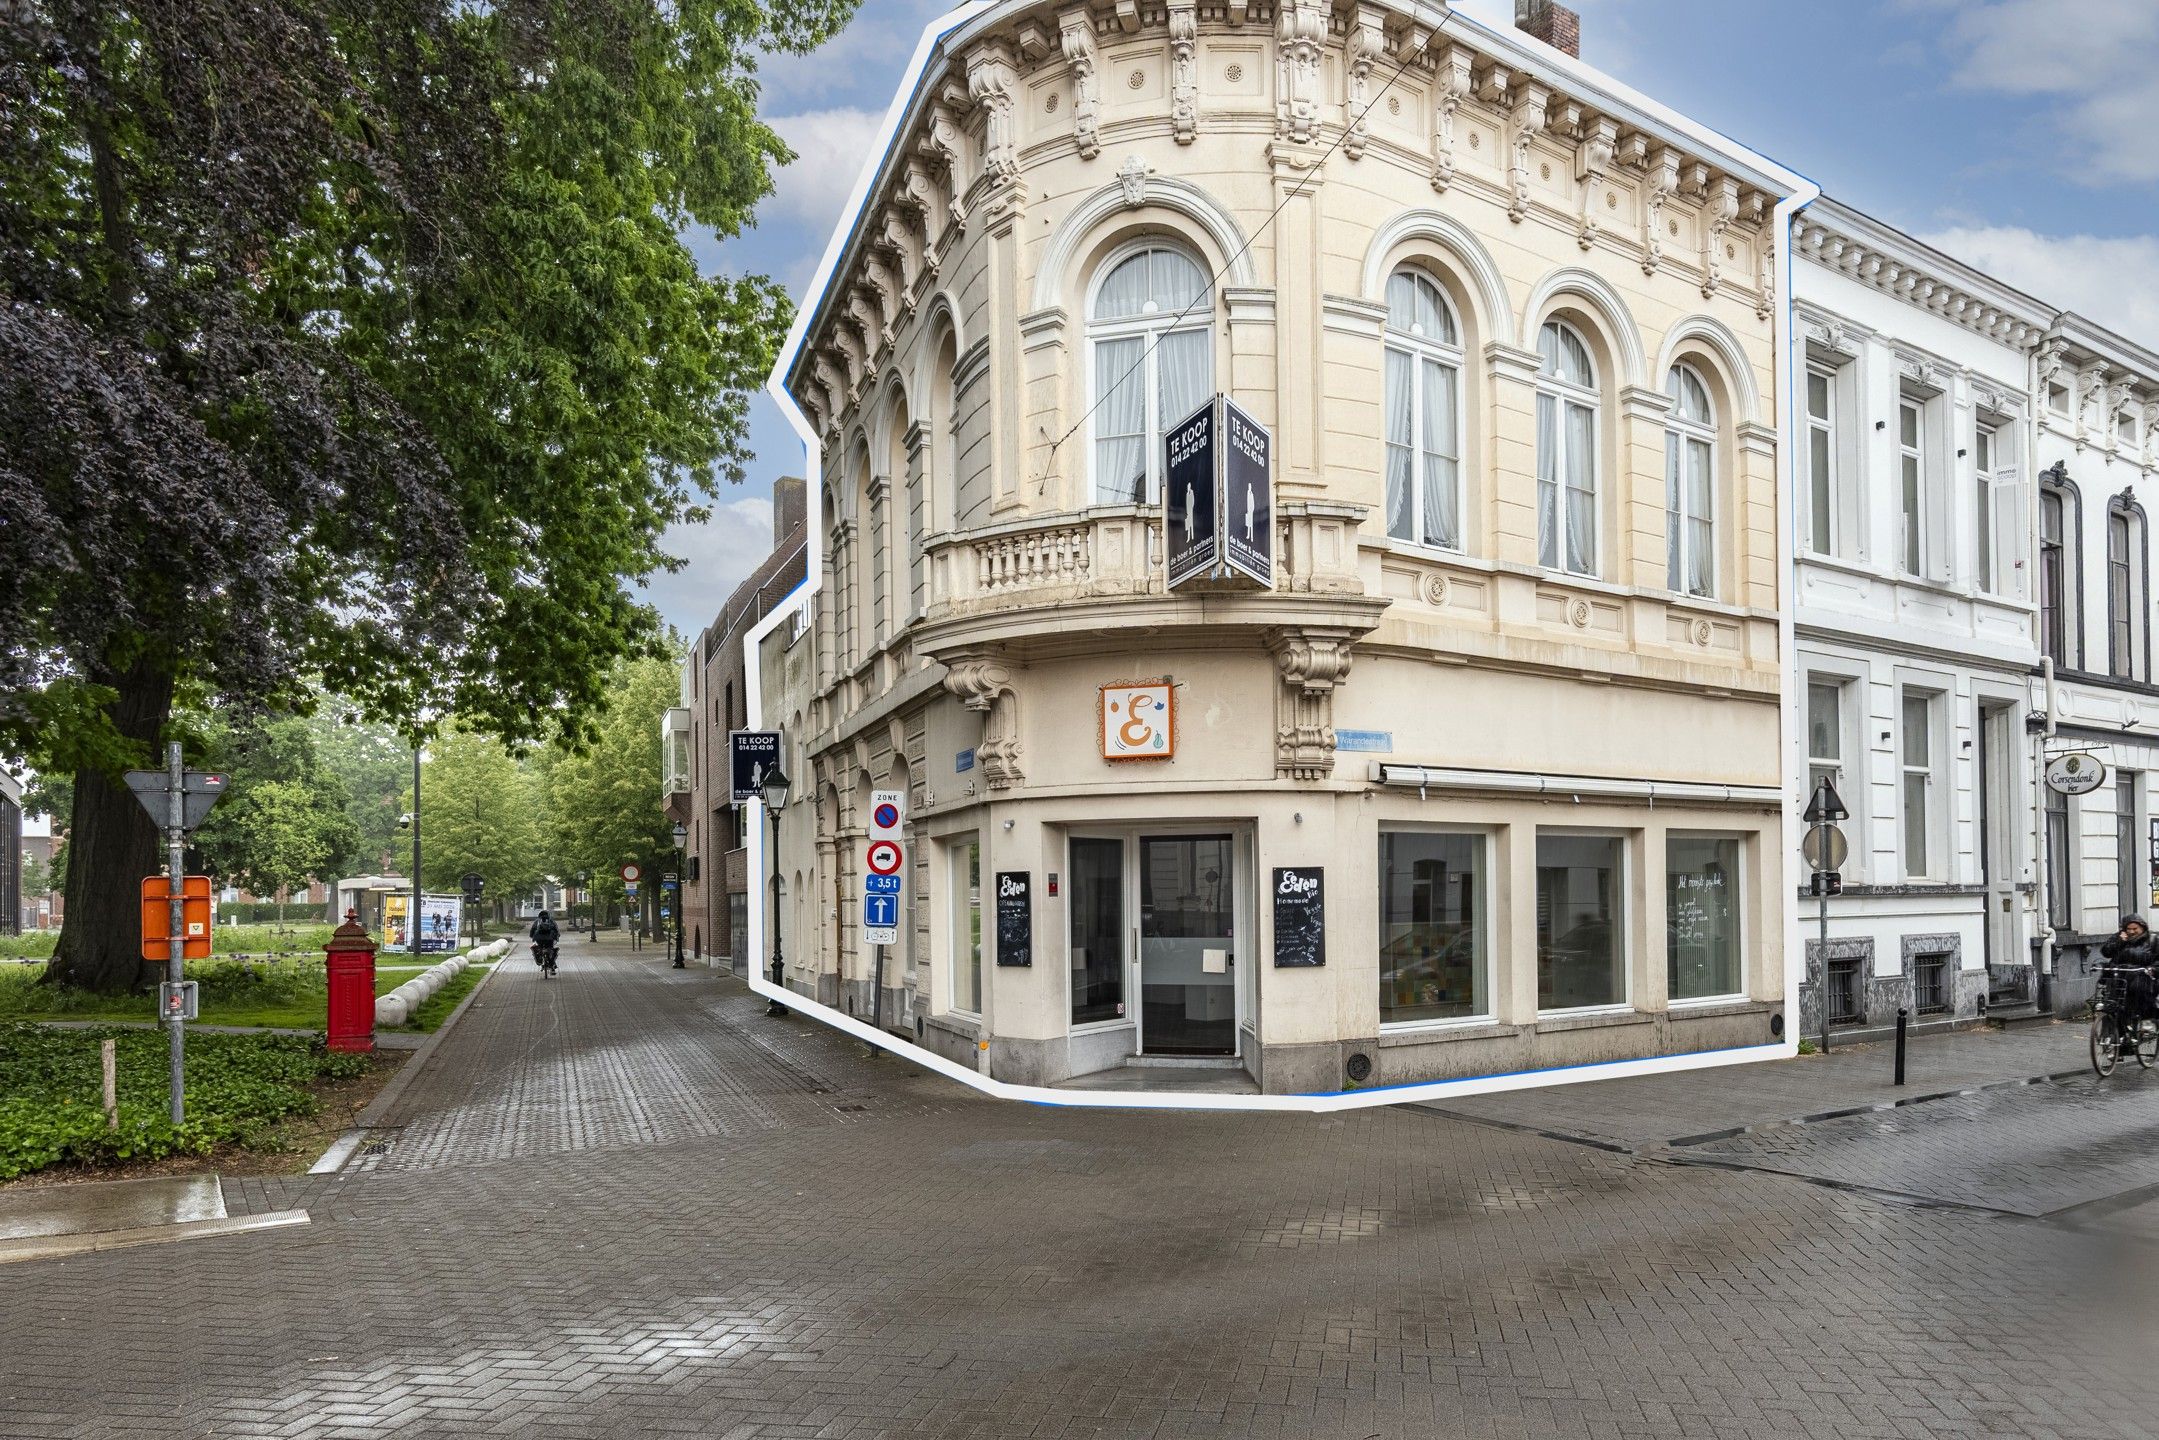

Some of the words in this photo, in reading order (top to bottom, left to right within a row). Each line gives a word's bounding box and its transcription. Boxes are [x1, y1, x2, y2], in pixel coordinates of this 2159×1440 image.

[1171, 437, 1180, 455] TE
[1181, 417, 1208, 448] KOOP
[1231, 416, 1241, 436] TE
[1242, 425, 1265, 453] KOOP
[1171, 452, 1182, 468] 014
[1182, 447, 1190, 460] 22
[1190, 441, 1198, 454] 42
[1199, 435, 1207, 449] 00
[1232, 435, 1243, 451] 014
[1243, 443, 1250, 457] 22
[1250, 449, 1257, 463] 42
[1257, 454, 1265, 468] 00
[1170, 556, 1176, 565] de
[1177, 550, 1188, 560] boer
[1193, 535, 1214, 554] partners
[1229, 534, 1236, 545] de
[1236, 538, 1248, 552] boer
[1252, 548, 1270, 566] partners
[1120, 693, 1153, 747] E
[749, 736, 775, 745] KOOP
[2051, 770, 2095, 784] Corsendonk
[2067, 783, 2079, 792] bier
[877, 878, 891, 889] 3,5
[893, 878, 897, 889] t
